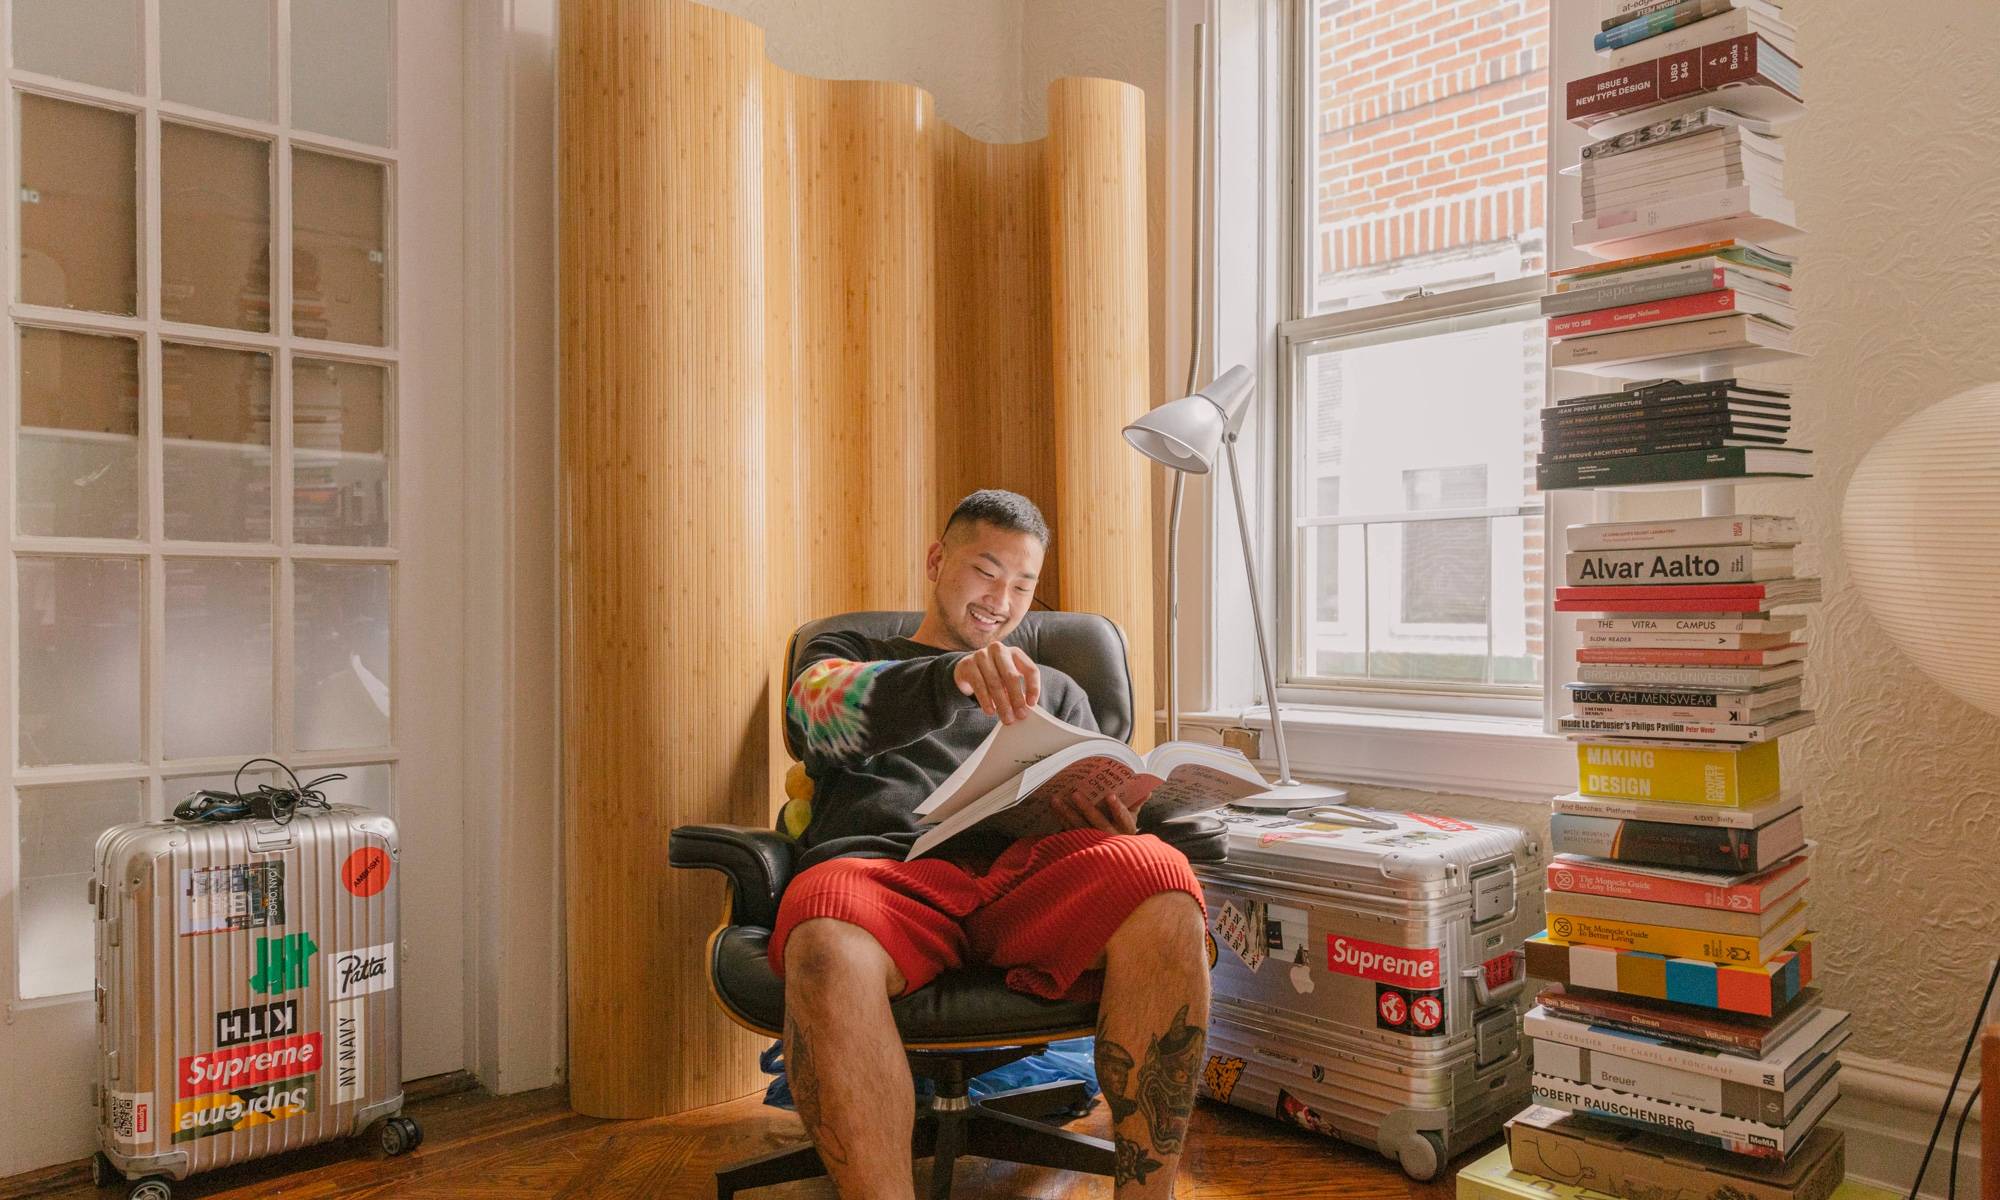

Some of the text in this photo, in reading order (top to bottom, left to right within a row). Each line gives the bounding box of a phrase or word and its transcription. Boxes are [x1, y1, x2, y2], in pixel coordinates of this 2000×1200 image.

[1730, 44, 1739, 70] Books
[1670, 63, 1679, 83] USD
[1680, 61, 1689, 79] $45
[1597, 78, 1622, 91] ISSUE
[1575, 81, 1651, 106] NEW TYPE DESIGN
[1597, 284, 1635, 302] paper
[1613, 308, 1660, 322] George Nelson
[1554, 319, 1592, 332] HOW TO SEE
[1598, 399, 1643, 409] ARCHITECTURE
[1593, 447, 1638, 457] ARCHITECTURE
[1579, 557, 1645, 580] Alvar
[1650, 553, 1720, 578] Aalto
[1598, 620, 1716, 630] THE VITRA CAMPUS
[1584, 669, 1749, 684] BRIGHAM YOUNG UNIVERSITY
[1574, 690, 1713, 706] FUCK YEAH MENSWEAR
[1561, 719, 1684, 732] Inside Le Corbusier's Philips Pavilion
[1586, 747, 1655, 768] MAKING
[1588, 774, 1651, 796] DESIGN
[1561, 803, 1574, 811] And
[1605, 806, 1637, 815] Platforms
[1579, 874, 1650, 890] The Monocle Guide
[1606, 884, 1632, 894] Homes
[1577, 922, 1649, 939] The Monocle Guide
[1588, 930, 1610, 940] Better
[1610, 932, 1635, 945] Living
[1333, 938, 1434, 978] Supreme
[336, 954, 387, 993] Patta
[1544, 997, 1559, 1008] Tom
[220, 1006, 293, 1042] KITH
[1704, 1029, 1734, 1043] Volume
[339, 1017, 356, 1087] NY NAVY
[1558, 1032, 1602, 1047] CORBUSIER
[1612, 1043, 1626, 1052] THE
[1631, 1046, 1664, 1062] CHAPEL
[1667, 1054, 1678, 1063] AT
[1681, 1057, 1734, 1075] RONCHAMP
[186, 1043, 314, 1086] Supreme
[1600, 1071, 1637, 1087] Breuer
[179, 1086, 308, 1130] Supreme
[1532, 1085, 1696, 1132] ROBERT RAUSCHENBERG
[1750, 1135, 1776, 1148] MoMA
